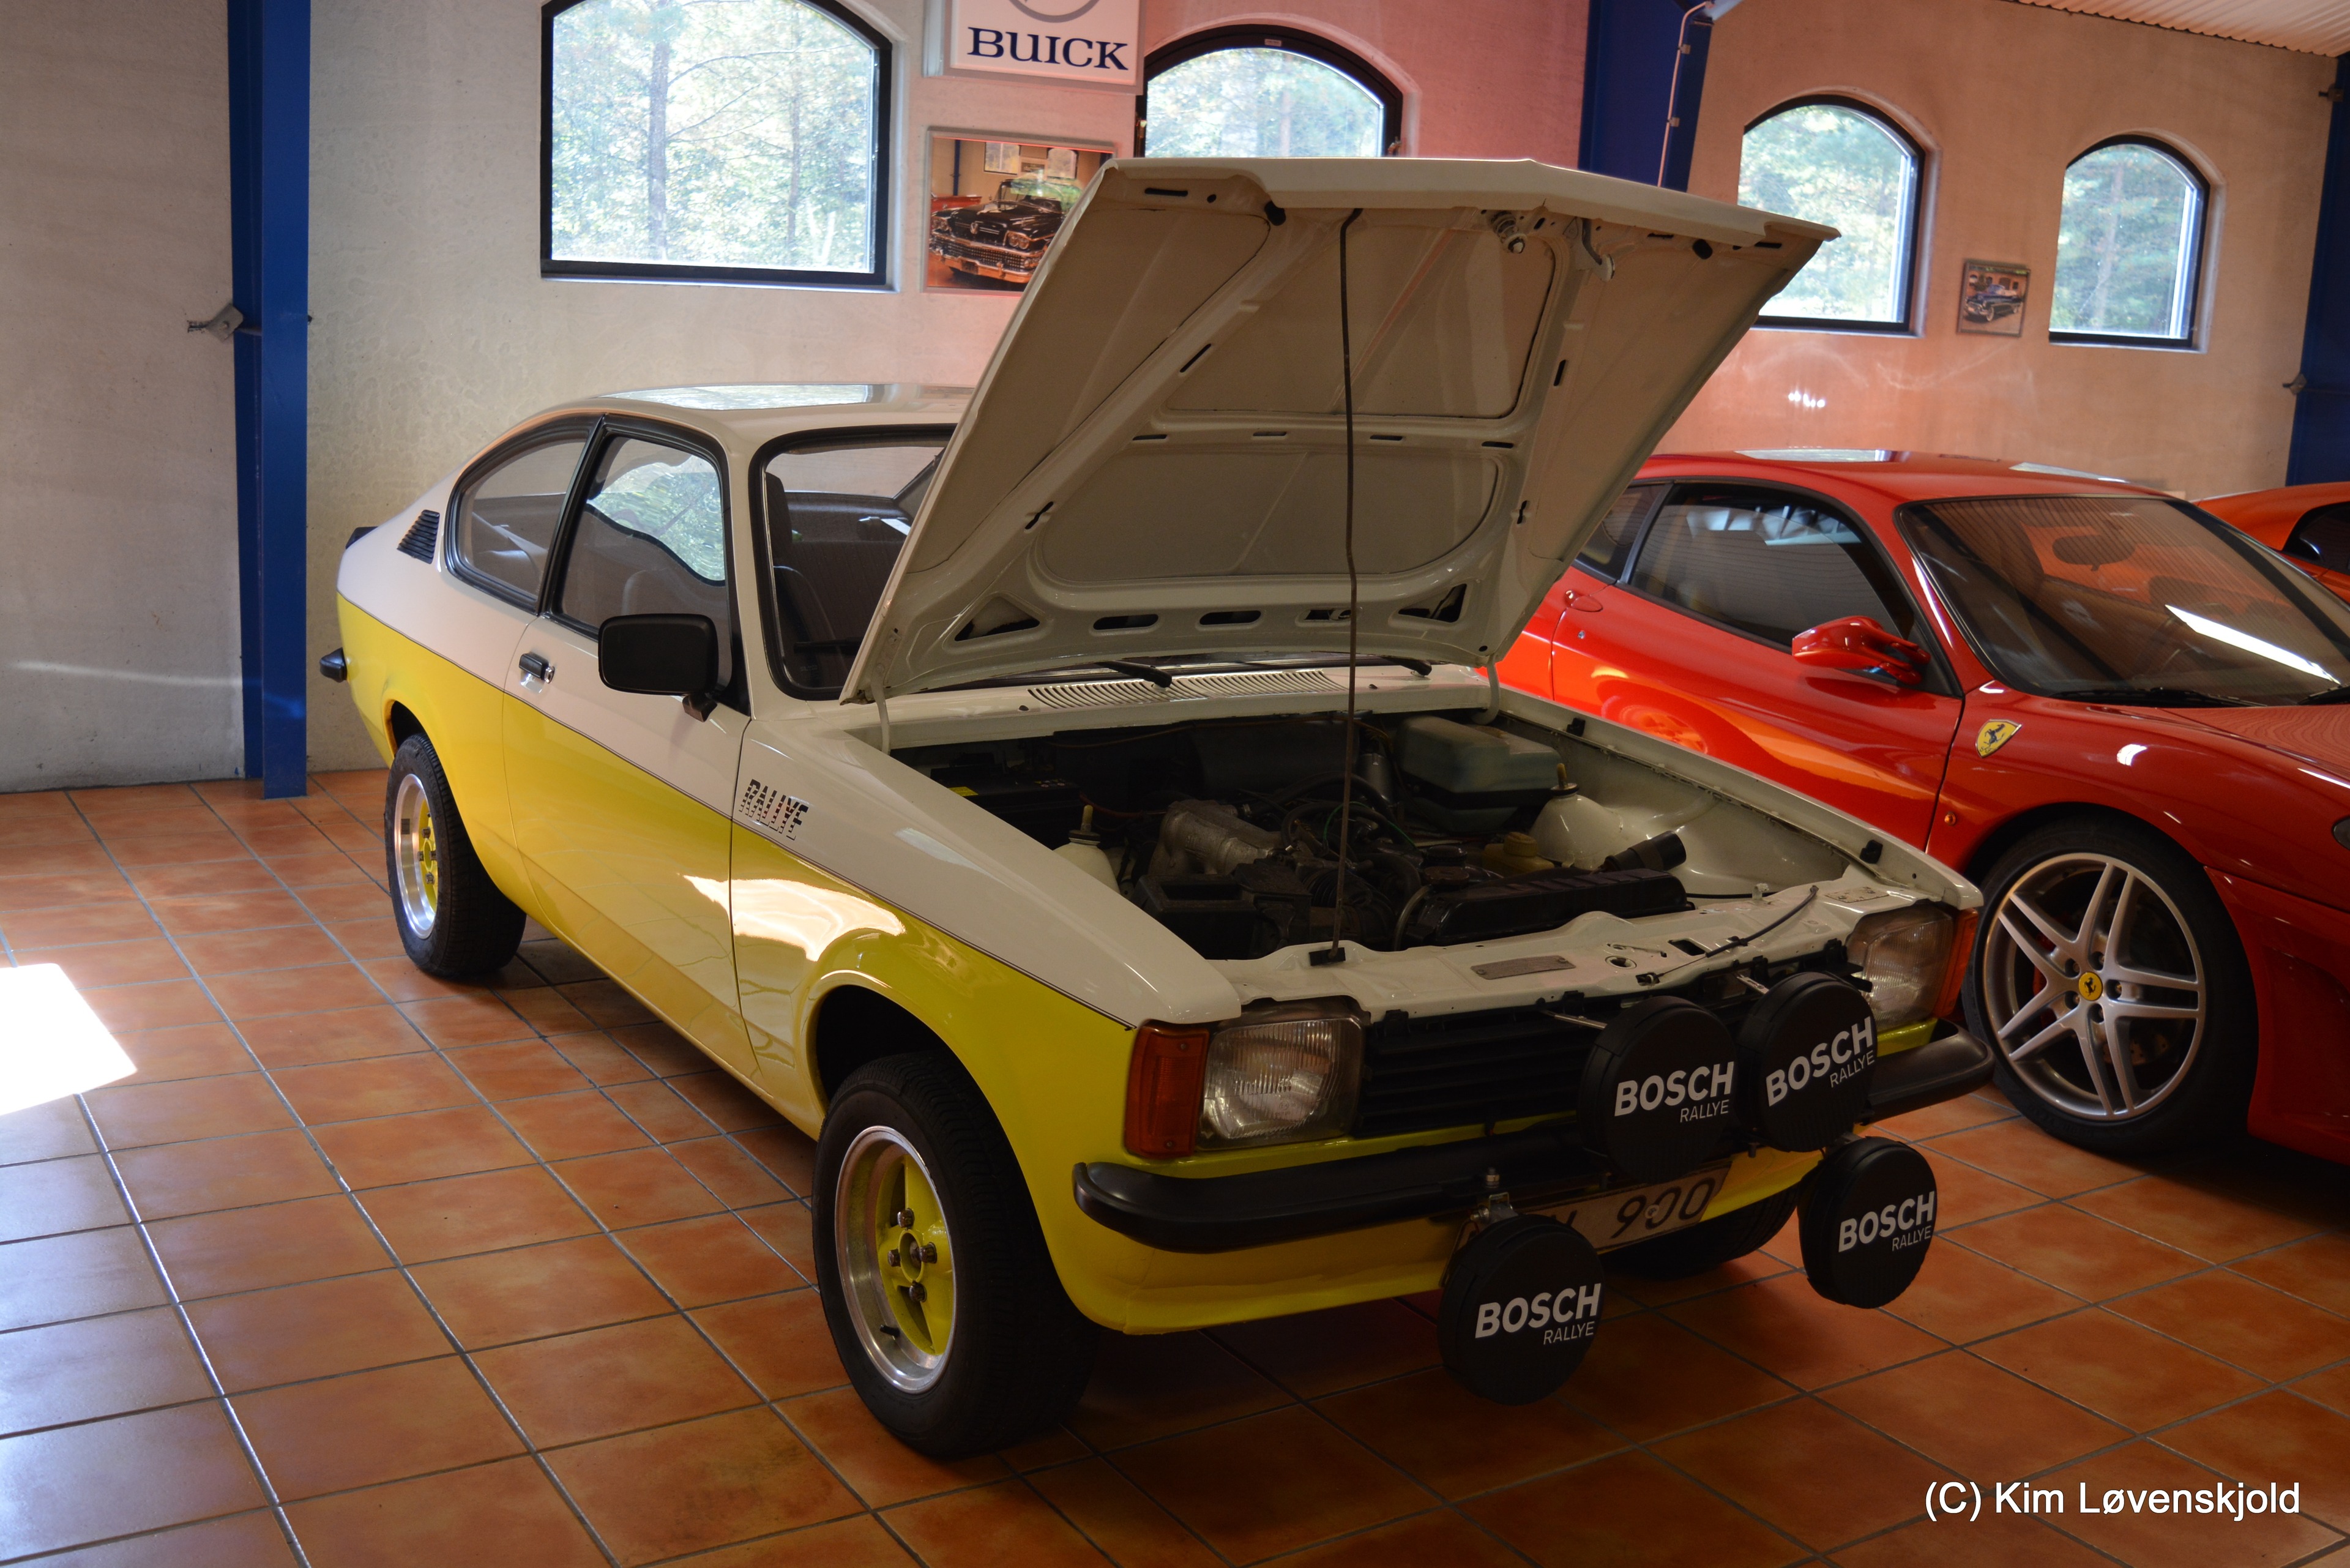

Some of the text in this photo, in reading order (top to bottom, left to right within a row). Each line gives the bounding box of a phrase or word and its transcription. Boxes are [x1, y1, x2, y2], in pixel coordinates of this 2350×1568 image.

[967, 26, 1129, 71] BUICK
[738, 778, 809, 842] RALLYE
[1614, 1061, 1735, 1117] BOSCH
[1766, 1015, 1873, 1107] BOSCH
[1829, 1050, 1875, 1088] RALLYE
[1679, 1099, 1729, 1123] RALLYE
[1610, 1177, 1715, 1240] 900
[1838, 1190, 1935, 1253] BOSCH
[1891, 1226, 1933, 1252] RALLYE
[1474, 1282, 1602, 1339] BOSCH
[1543, 1321, 1595, 1345] RALLYE
